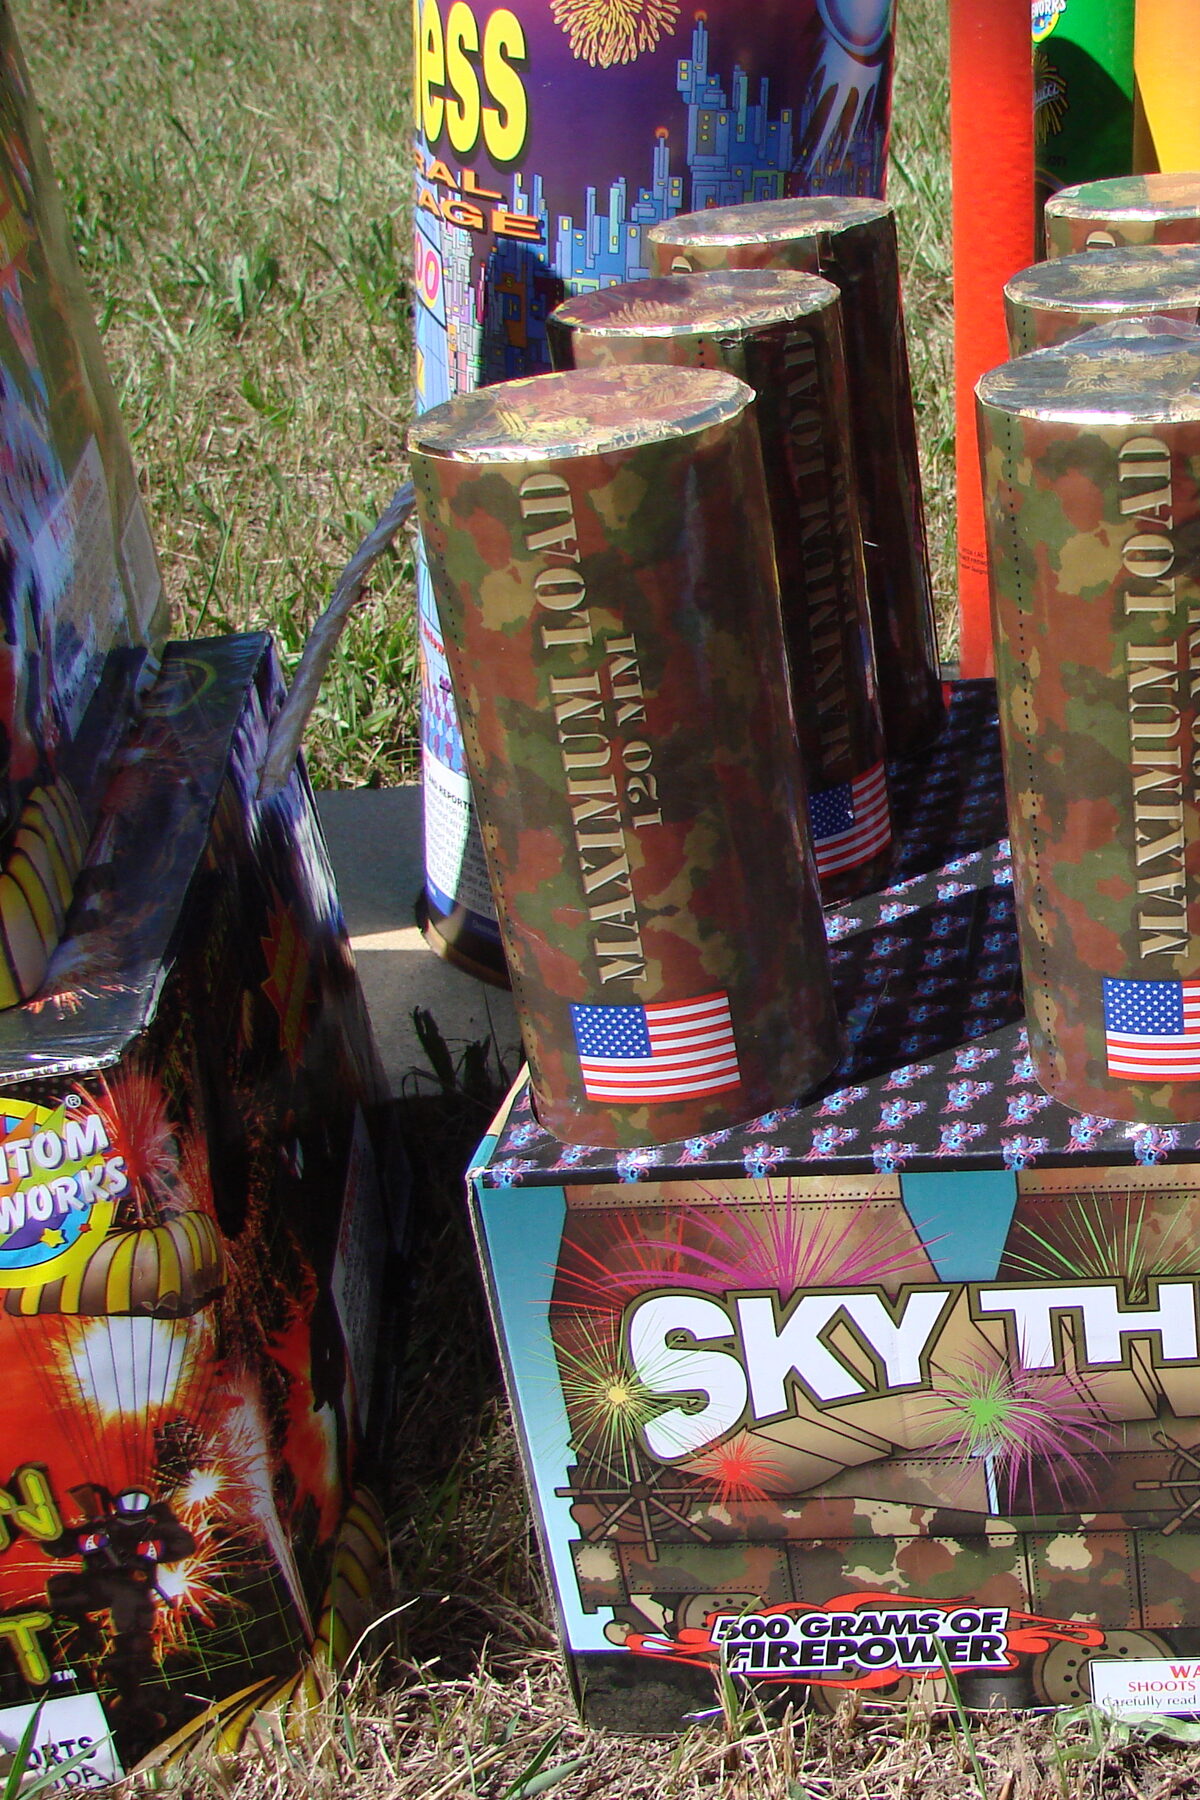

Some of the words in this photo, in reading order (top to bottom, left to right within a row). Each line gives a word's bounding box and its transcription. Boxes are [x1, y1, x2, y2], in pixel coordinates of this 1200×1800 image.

[519, 473, 593, 649] LOAD
[1117, 436, 1176, 615] LOAD
[605, 632, 648, 727] MM
[549, 670, 648, 985] MAXIMUM
[622, 740, 663, 830] 120
[1127, 641, 1189, 959] MAXIMUM
[0, 1113, 110, 1183] TOM
[628, 1287, 953, 1460] SKY
[716, 1615, 783, 1640] 500
[788, 1611, 940, 1637] GRAMS
[946, 1609, 1004, 1634] OF
[726, 1636, 1004, 1672] FIREPOWER
[1102, 1694, 1163, 1709] Carefully
[1167, 1694, 1196, 1705] read
[1128, 1679, 1197, 1693] SHOOTS
